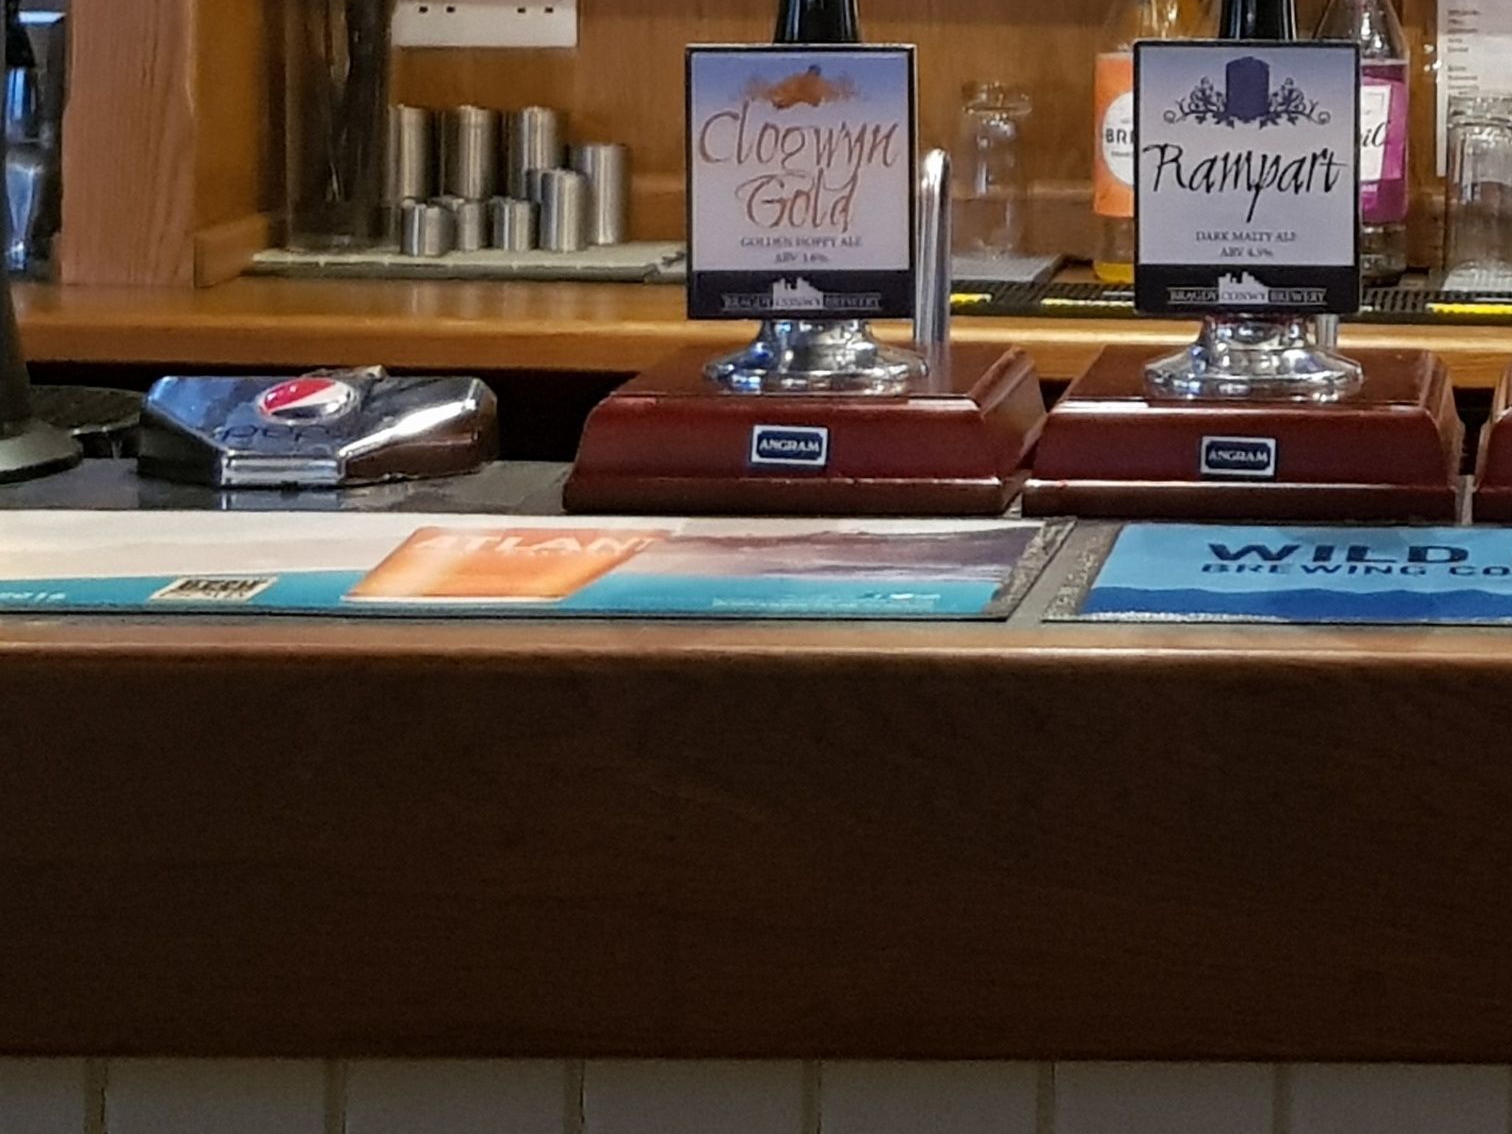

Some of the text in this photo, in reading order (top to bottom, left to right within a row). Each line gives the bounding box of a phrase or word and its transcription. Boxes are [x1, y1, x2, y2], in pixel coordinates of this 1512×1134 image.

[1142, 143, 1350, 223] Rampart
[735, 169, 860, 233] Gold
[1195, 231, 1297, 242] DARK MALTY ALE
[1220, 247, 1245, 257] ABV
[1269, 290, 1325, 302] BREWERY
[759, 438, 820, 453] ANGRAM
[1208, 449, 1269, 465] ANGRAM
[1208, 543, 1470, 564] WILD
[1201, 564, 1427, 575] BREWING
